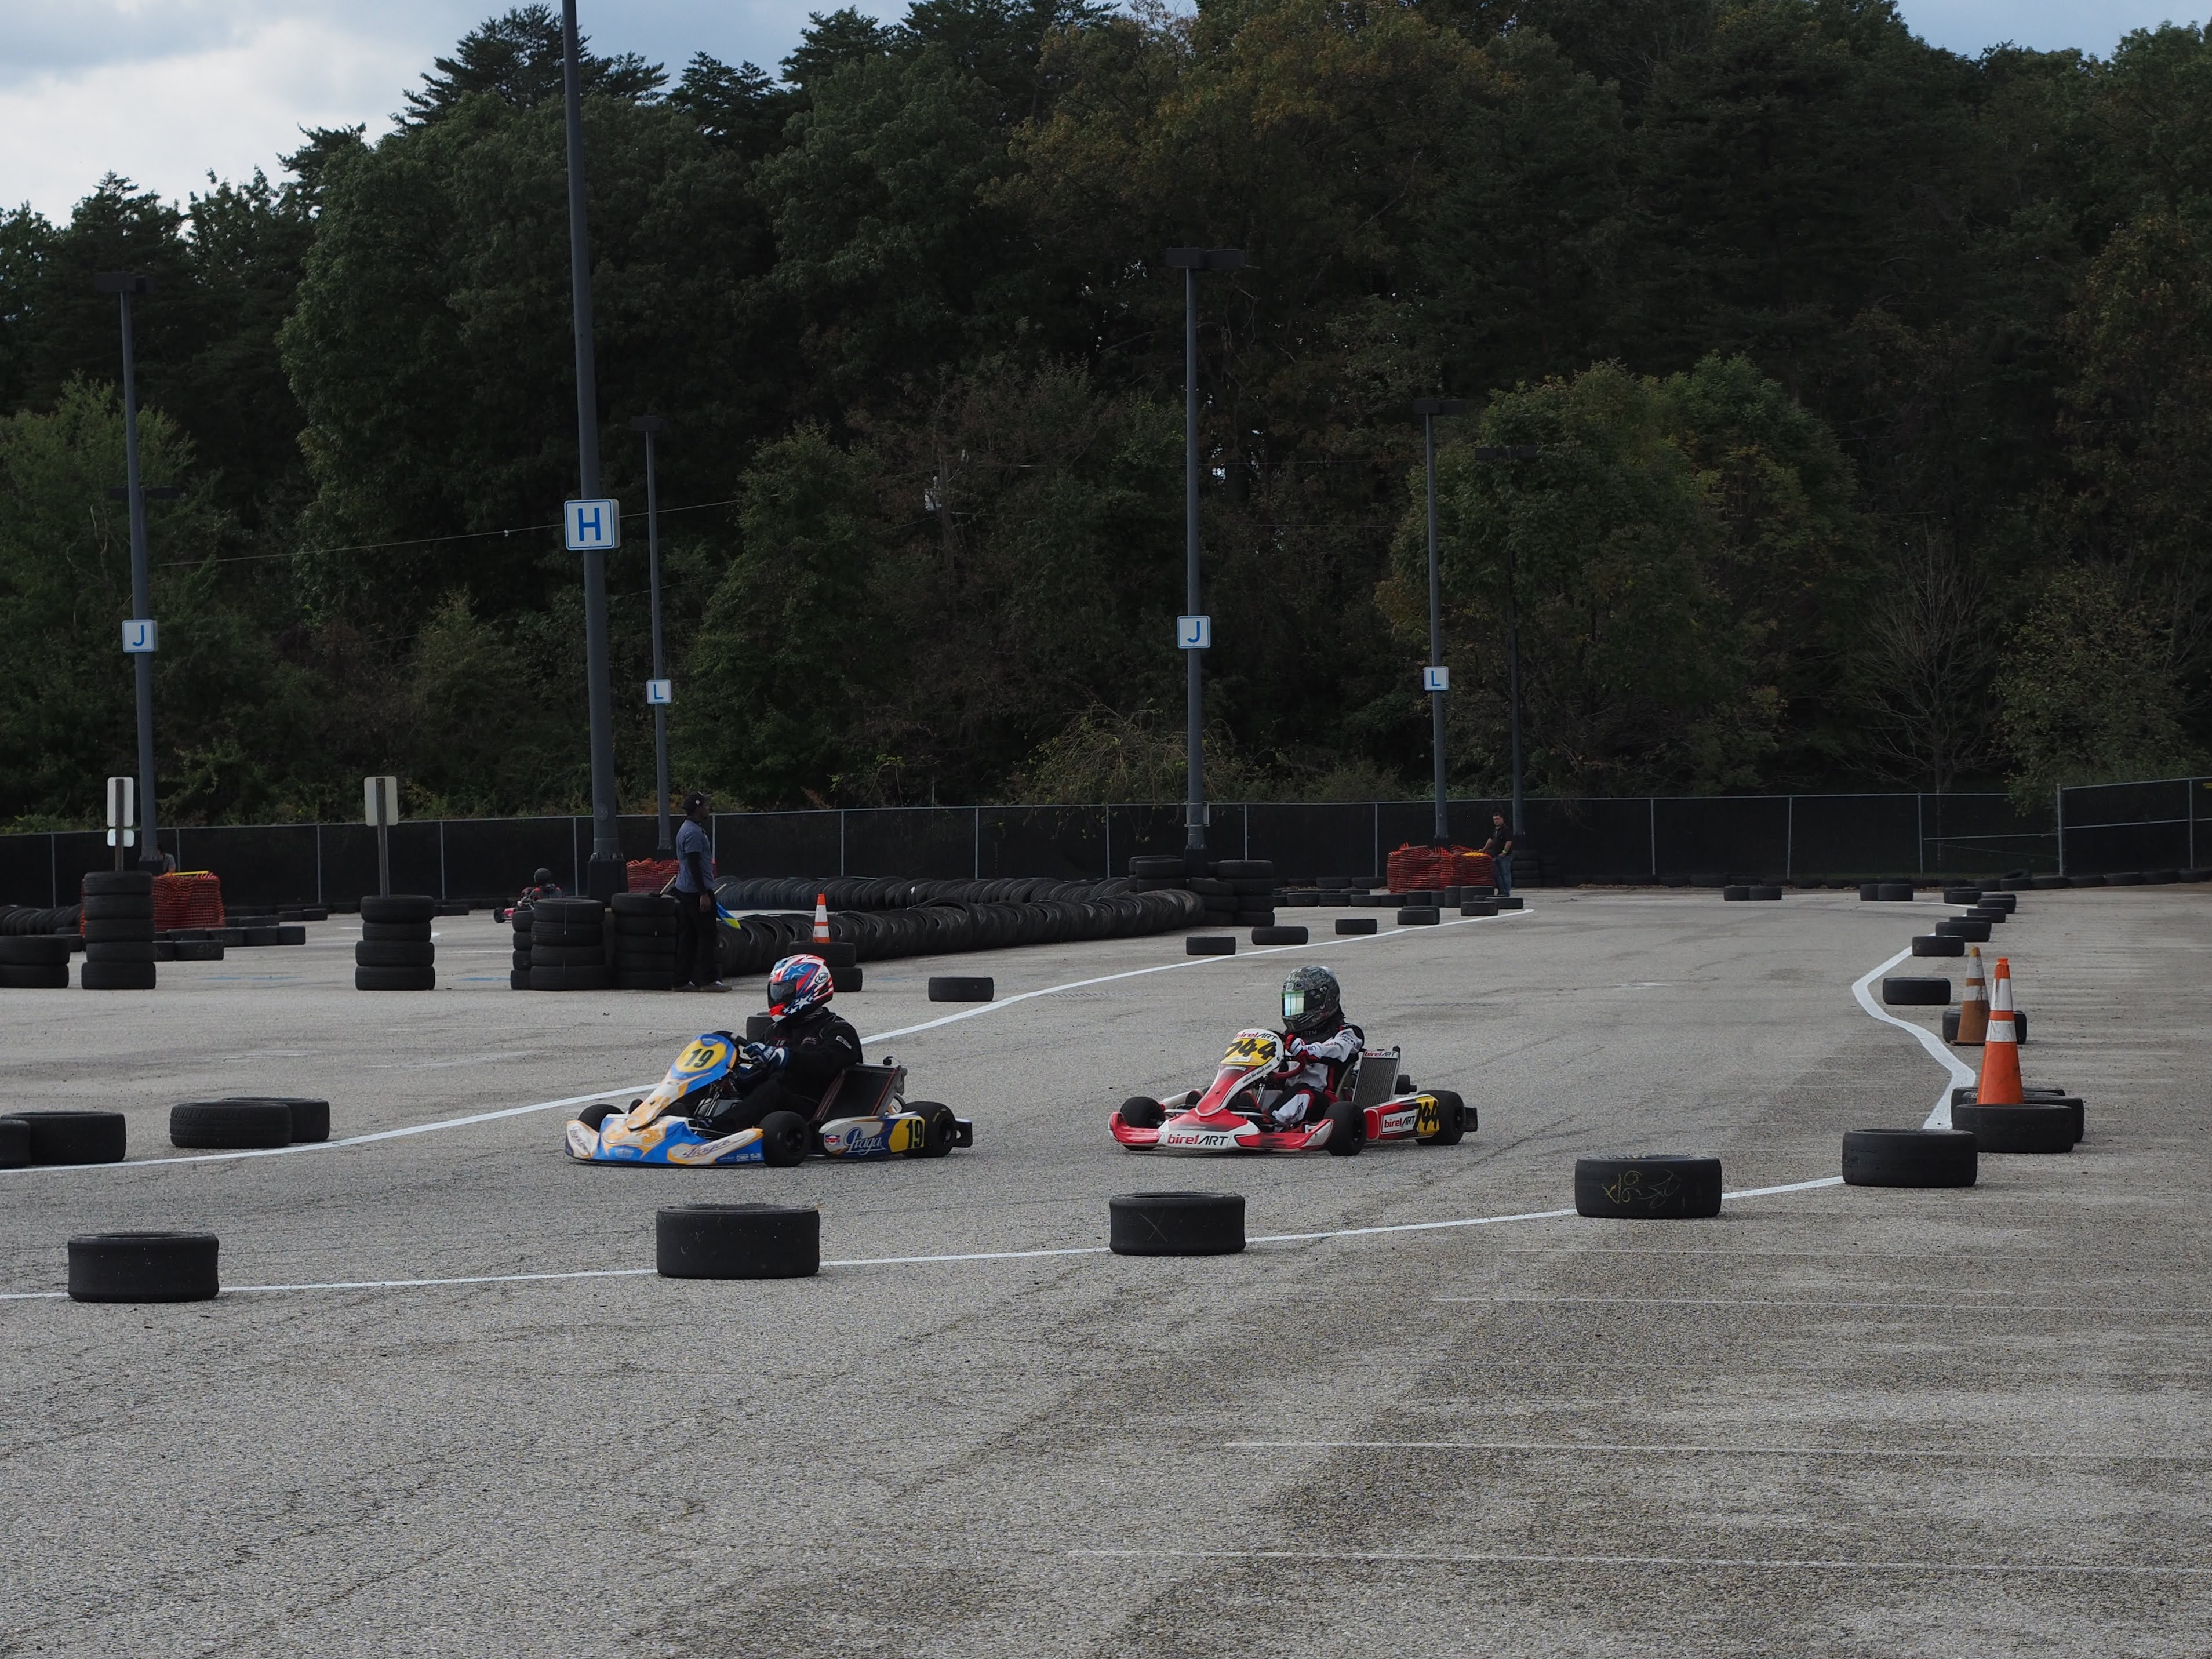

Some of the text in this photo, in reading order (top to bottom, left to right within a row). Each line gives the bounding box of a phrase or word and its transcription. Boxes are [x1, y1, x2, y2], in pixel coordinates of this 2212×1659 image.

[577, 507, 601, 541] H
[132, 625, 145, 647] J
[1187, 621, 1200, 643] J
[1431, 671, 1442, 687] L
[653, 684, 664, 700] L
[684, 1048, 714, 1068] 19
[1384, 1115, 1416, 1129] birelART
[845, 1126, 886, 1156] Praga
[906, 1119, 923, 1148] 19
[1167, 1134, 1228, 1146] birelART
